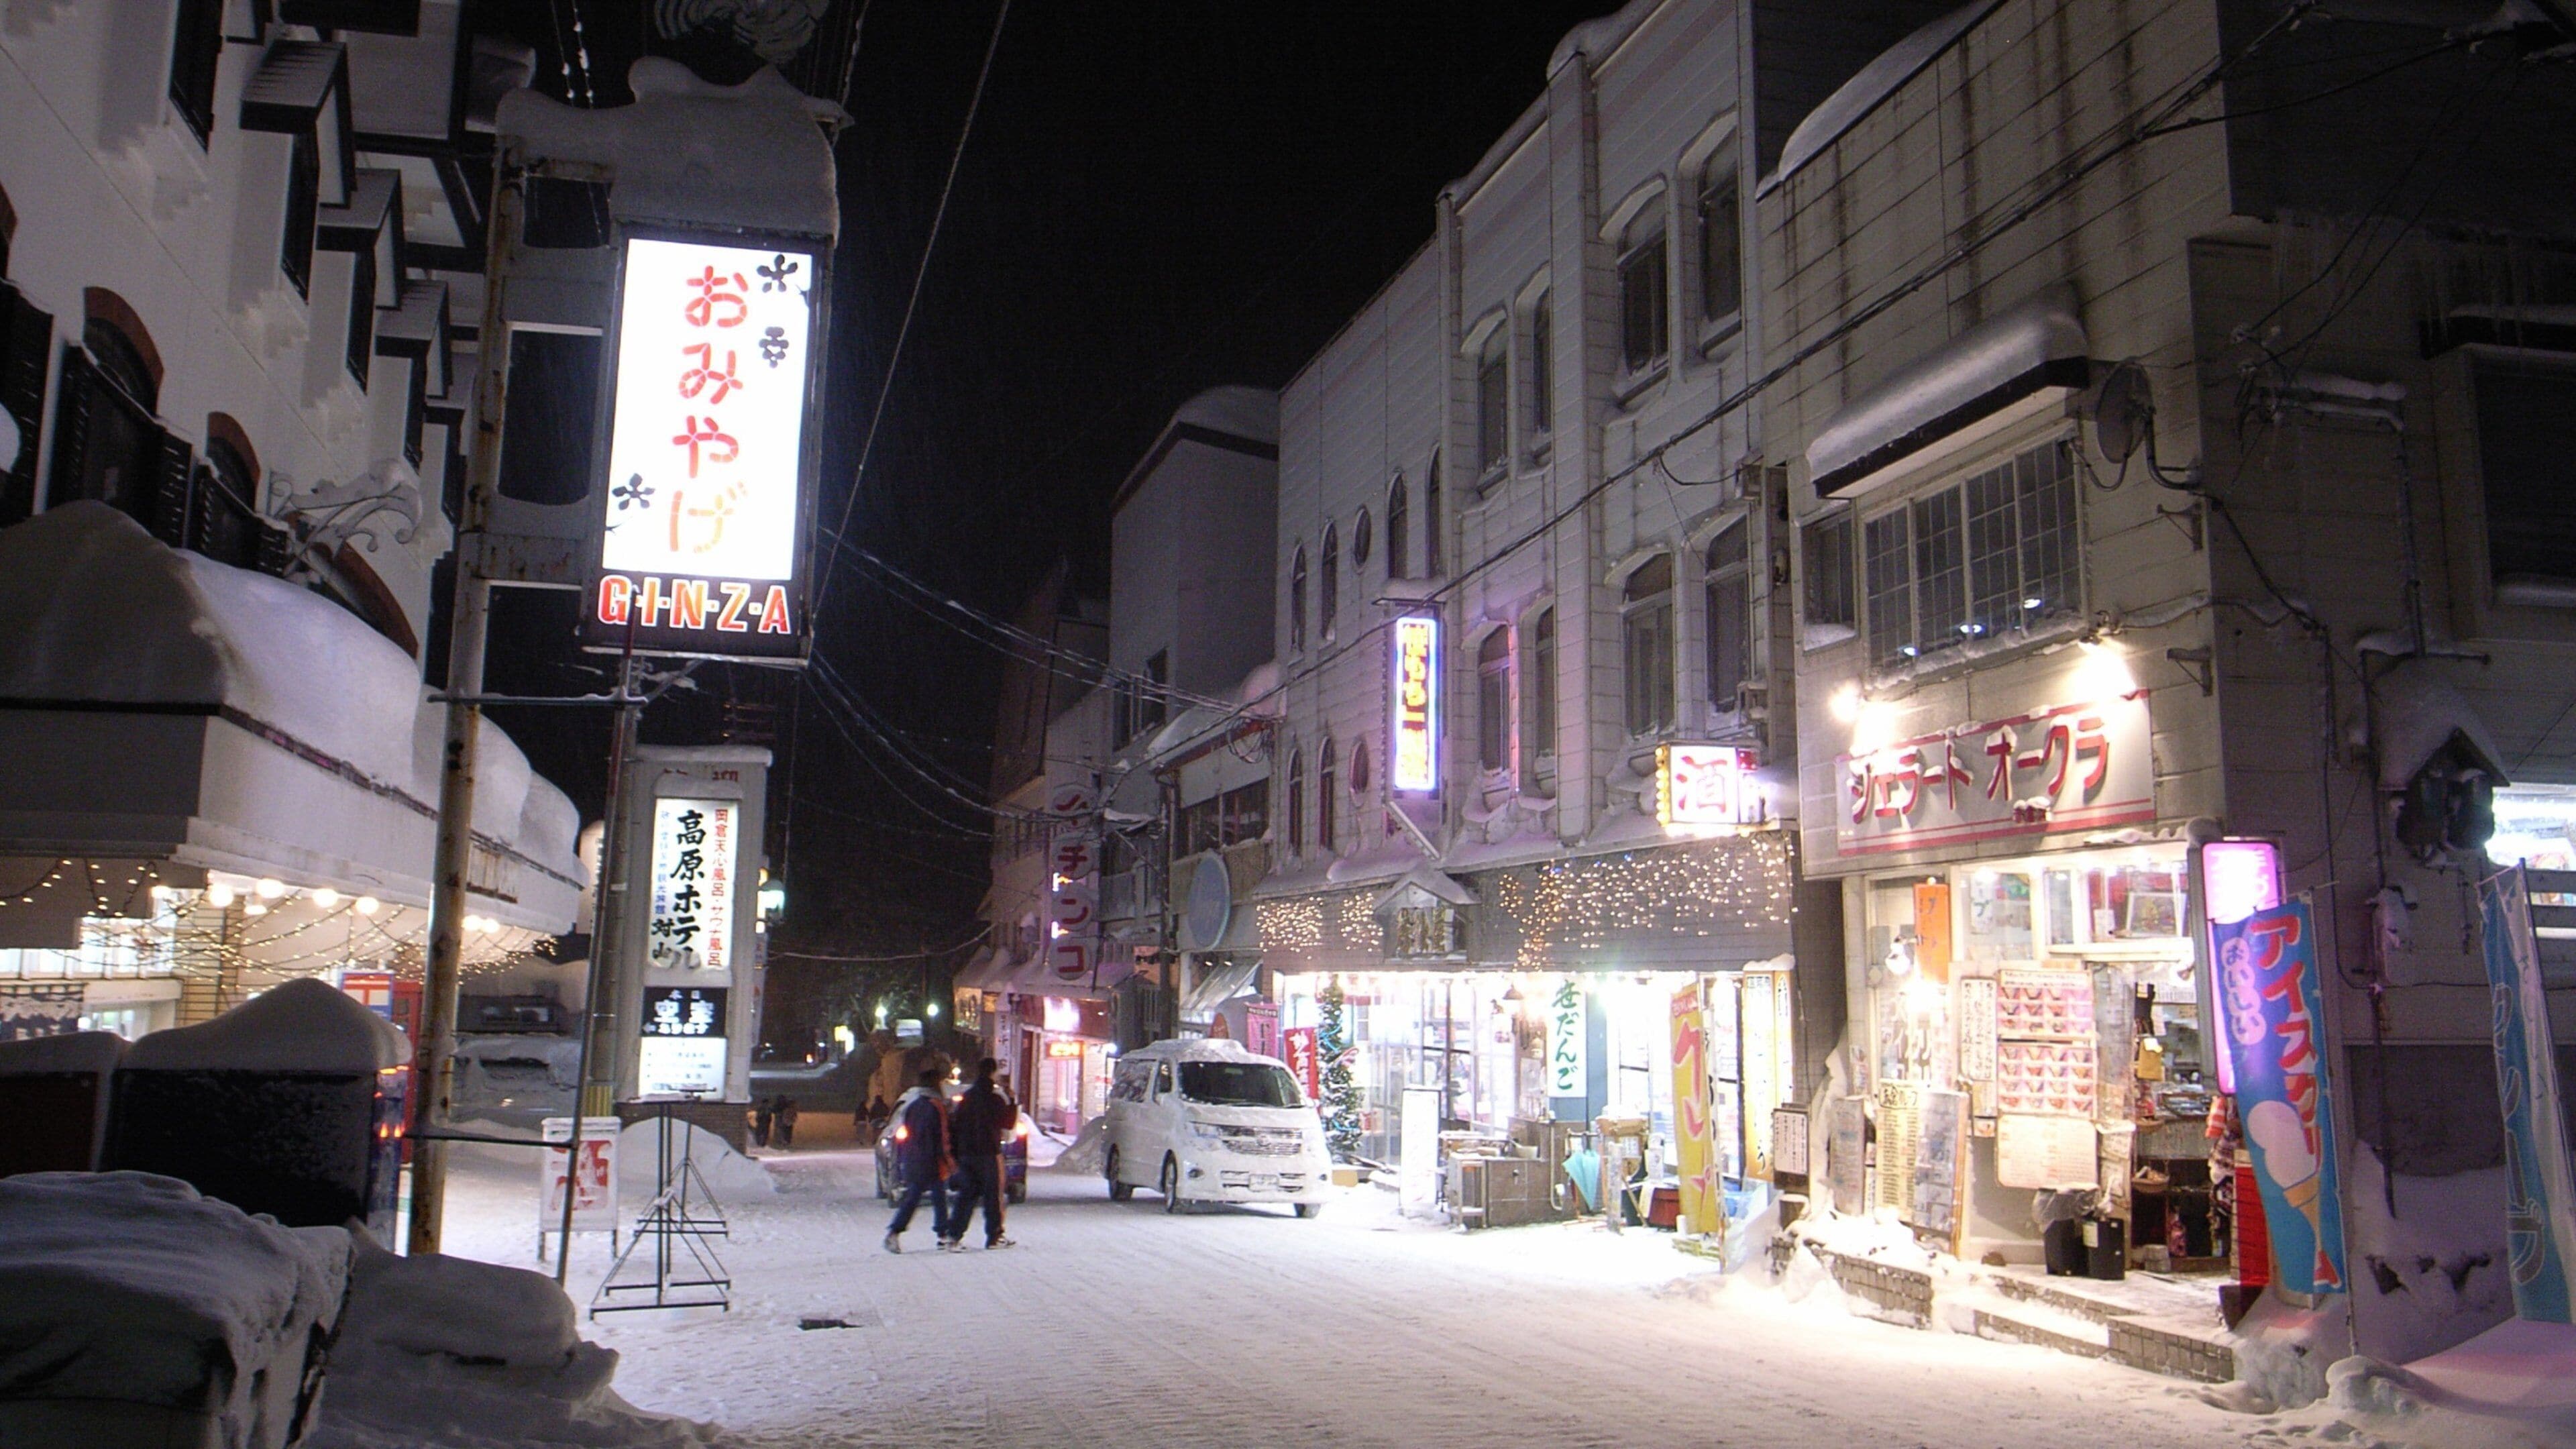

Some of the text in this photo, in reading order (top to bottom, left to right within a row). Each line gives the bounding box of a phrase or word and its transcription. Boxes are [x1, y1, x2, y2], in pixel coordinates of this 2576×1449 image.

[669, 265, 749, 553] おみやげ
[1676, 755, 1728, 814] 酒
[670, 809, 706, 970] 高原ホテル
[1552, 979, 1581, 1090] 笹だんご
[2226, 943, 2261, 1036] おいしい
